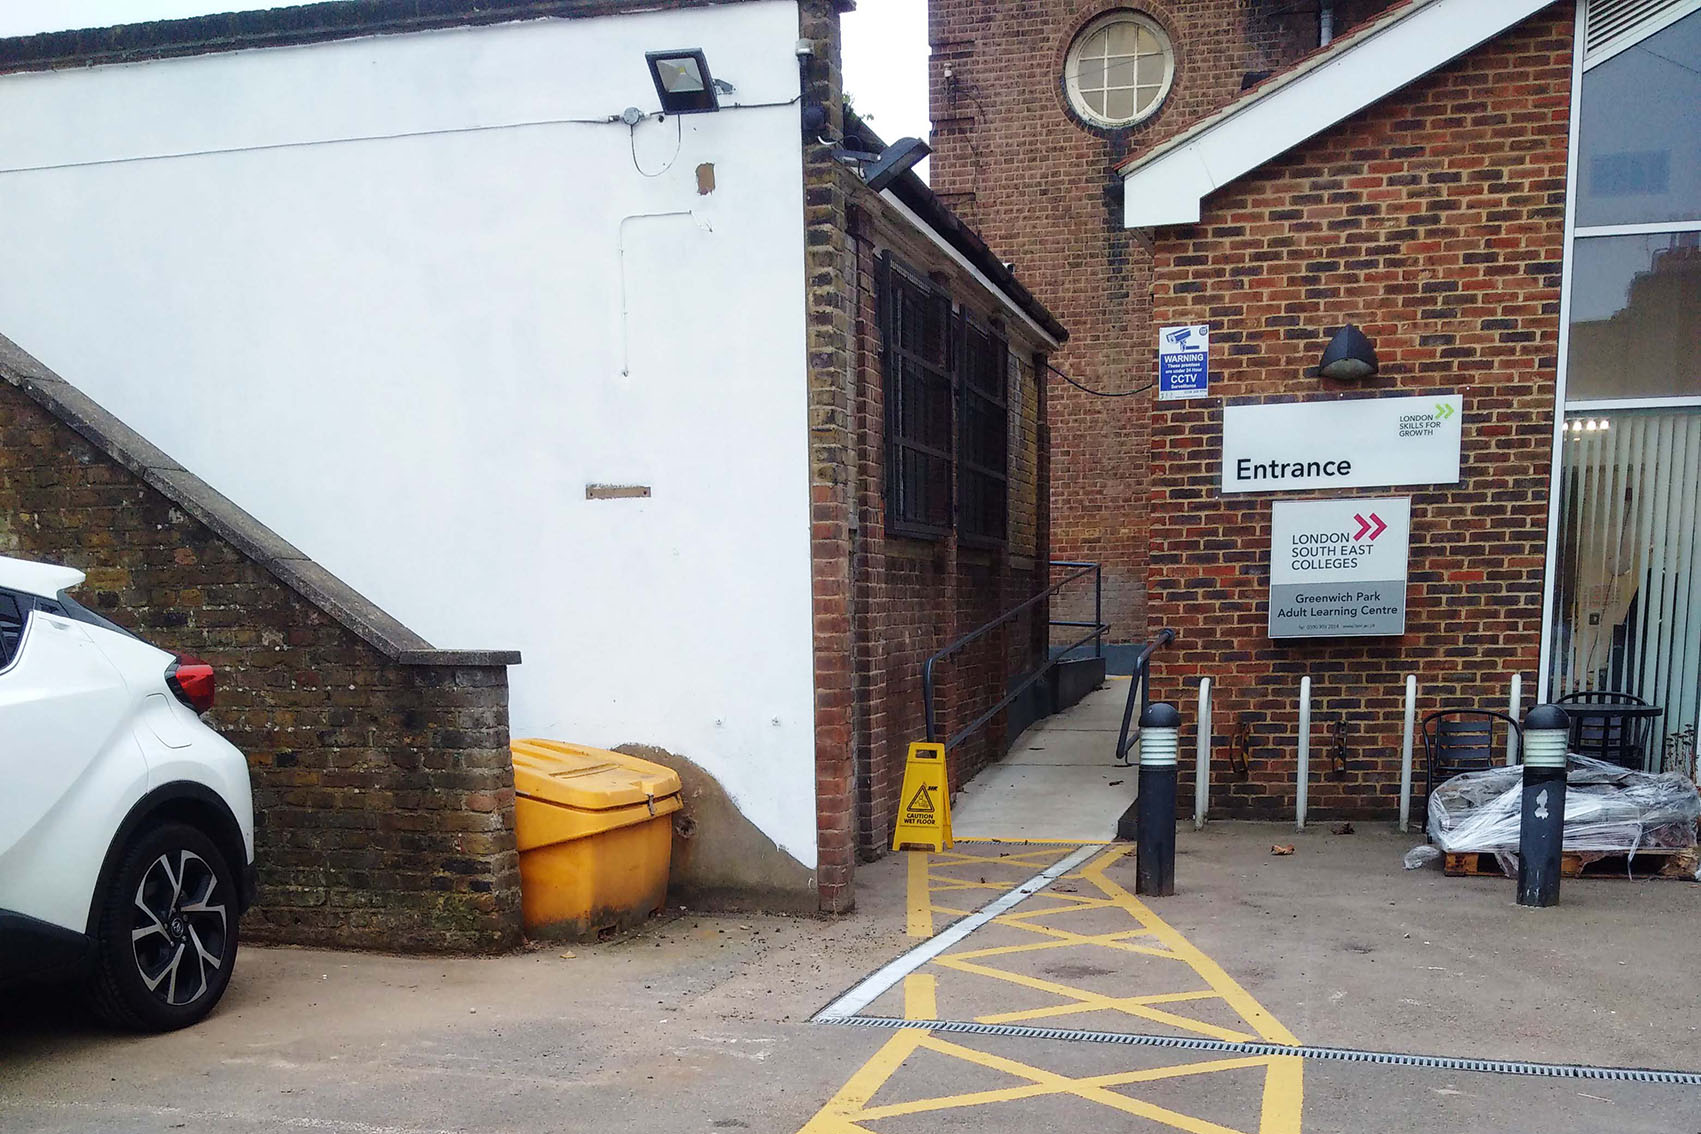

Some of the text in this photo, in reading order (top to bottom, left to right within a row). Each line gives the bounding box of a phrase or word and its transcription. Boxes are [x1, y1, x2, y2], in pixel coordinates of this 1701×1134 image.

[1164, 354, 1204, 363] WARNING
[1171, 374, 1197, 383] CCTV
[1399, 414, 1433, 422] LONDON
[1399, 422, 1424, 430] SKILLS
[1399, 429, 1433, 437] GROWTH
[1237, 458, 1351, 480] Entrance
[1292, 532, 1350, 545] LONDON
[1291, 544, 1374, 557] SOUTH EAST
[1291, 557, 1358, 570] COLLEGES
[1295, 591, 1381, 603] Greenwich Park
[1277, 605, 1398, 618] Adult Learning Centre
